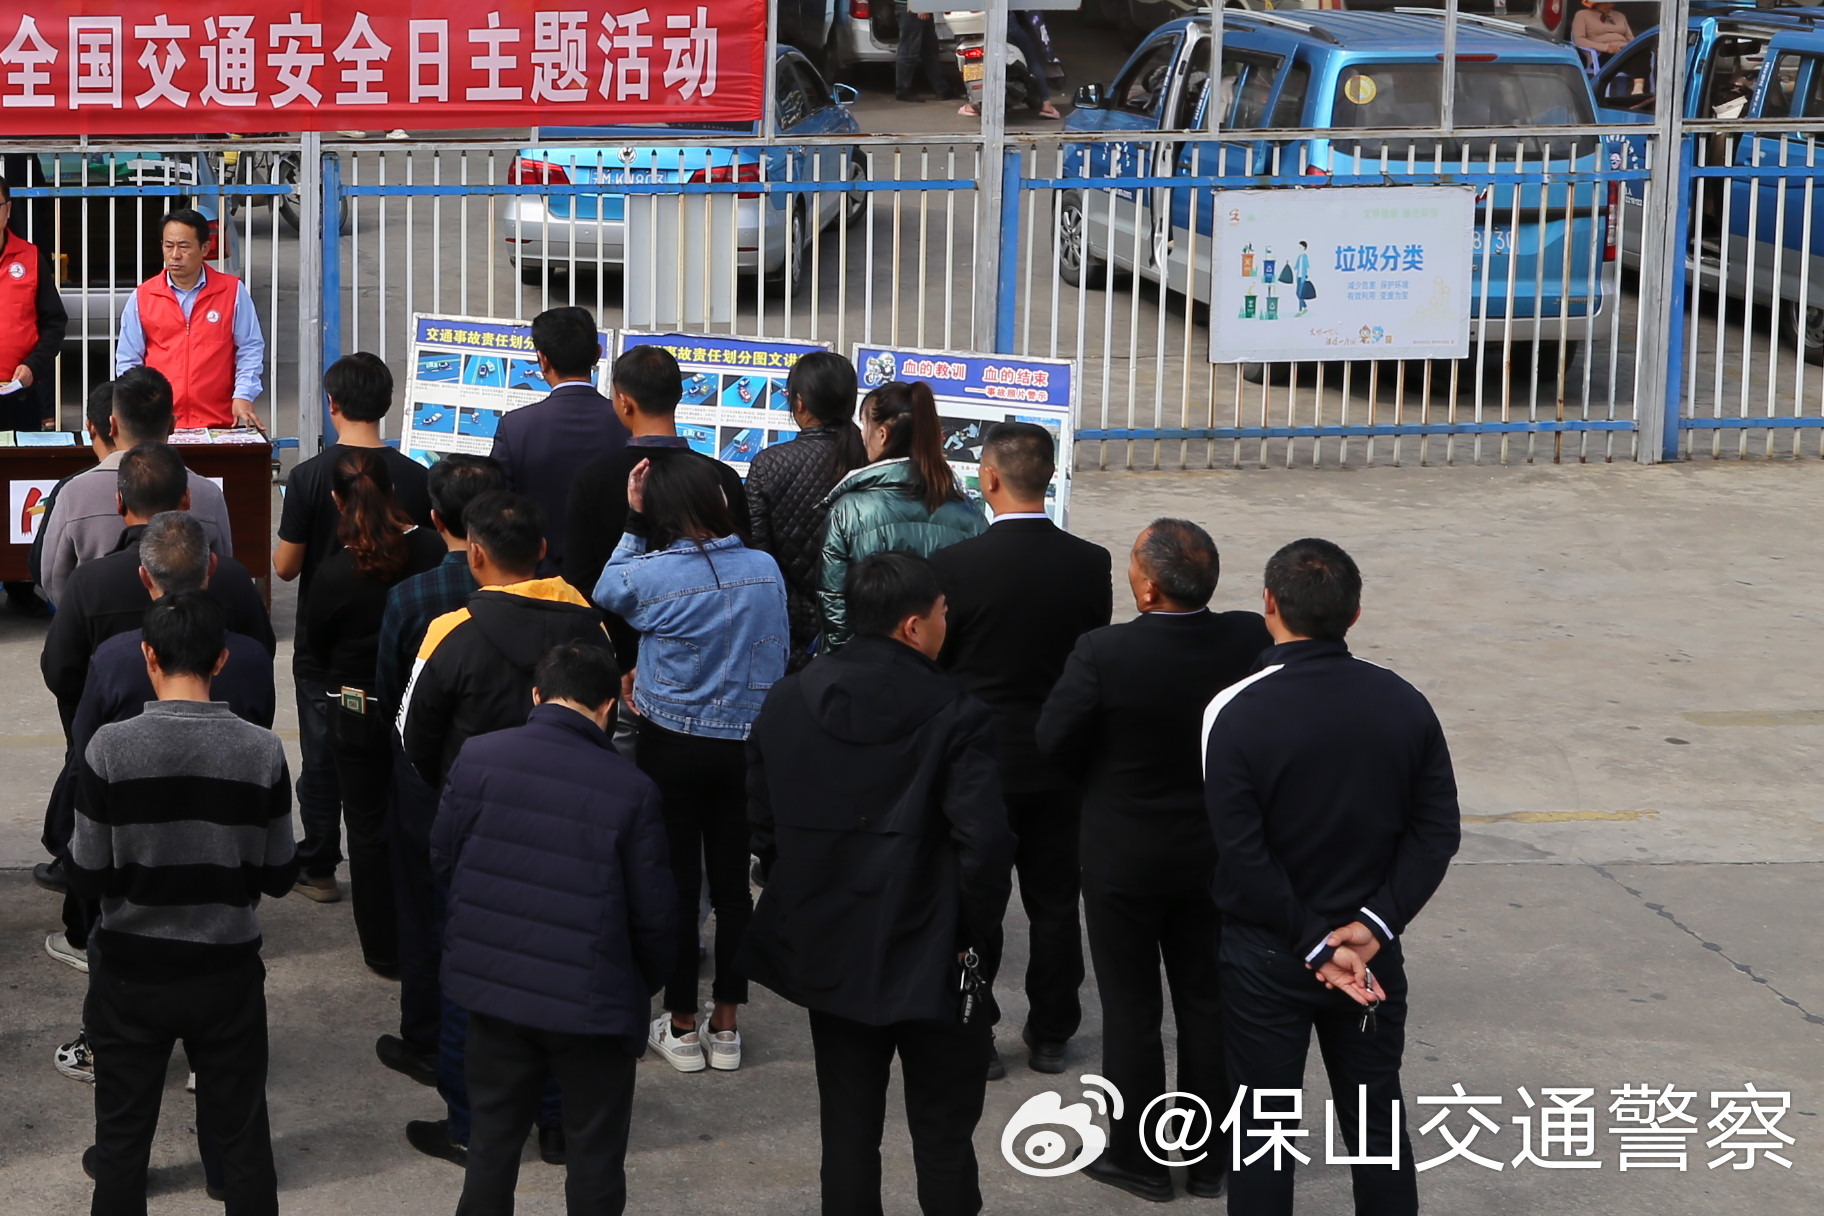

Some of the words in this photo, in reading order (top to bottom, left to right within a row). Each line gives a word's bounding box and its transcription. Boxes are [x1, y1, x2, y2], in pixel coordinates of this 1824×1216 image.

[1334, 244, 1424, 272] 垃圾分类
[1347, 280, 1376, 290] 减少危害
[1380, 280, 1409, 289] 保护环境
[1347, 291, 1376, 301] 有效利用
[902, 359, 966, 381] 血的教训
[982, 365, 1049, 387] 血的结束
